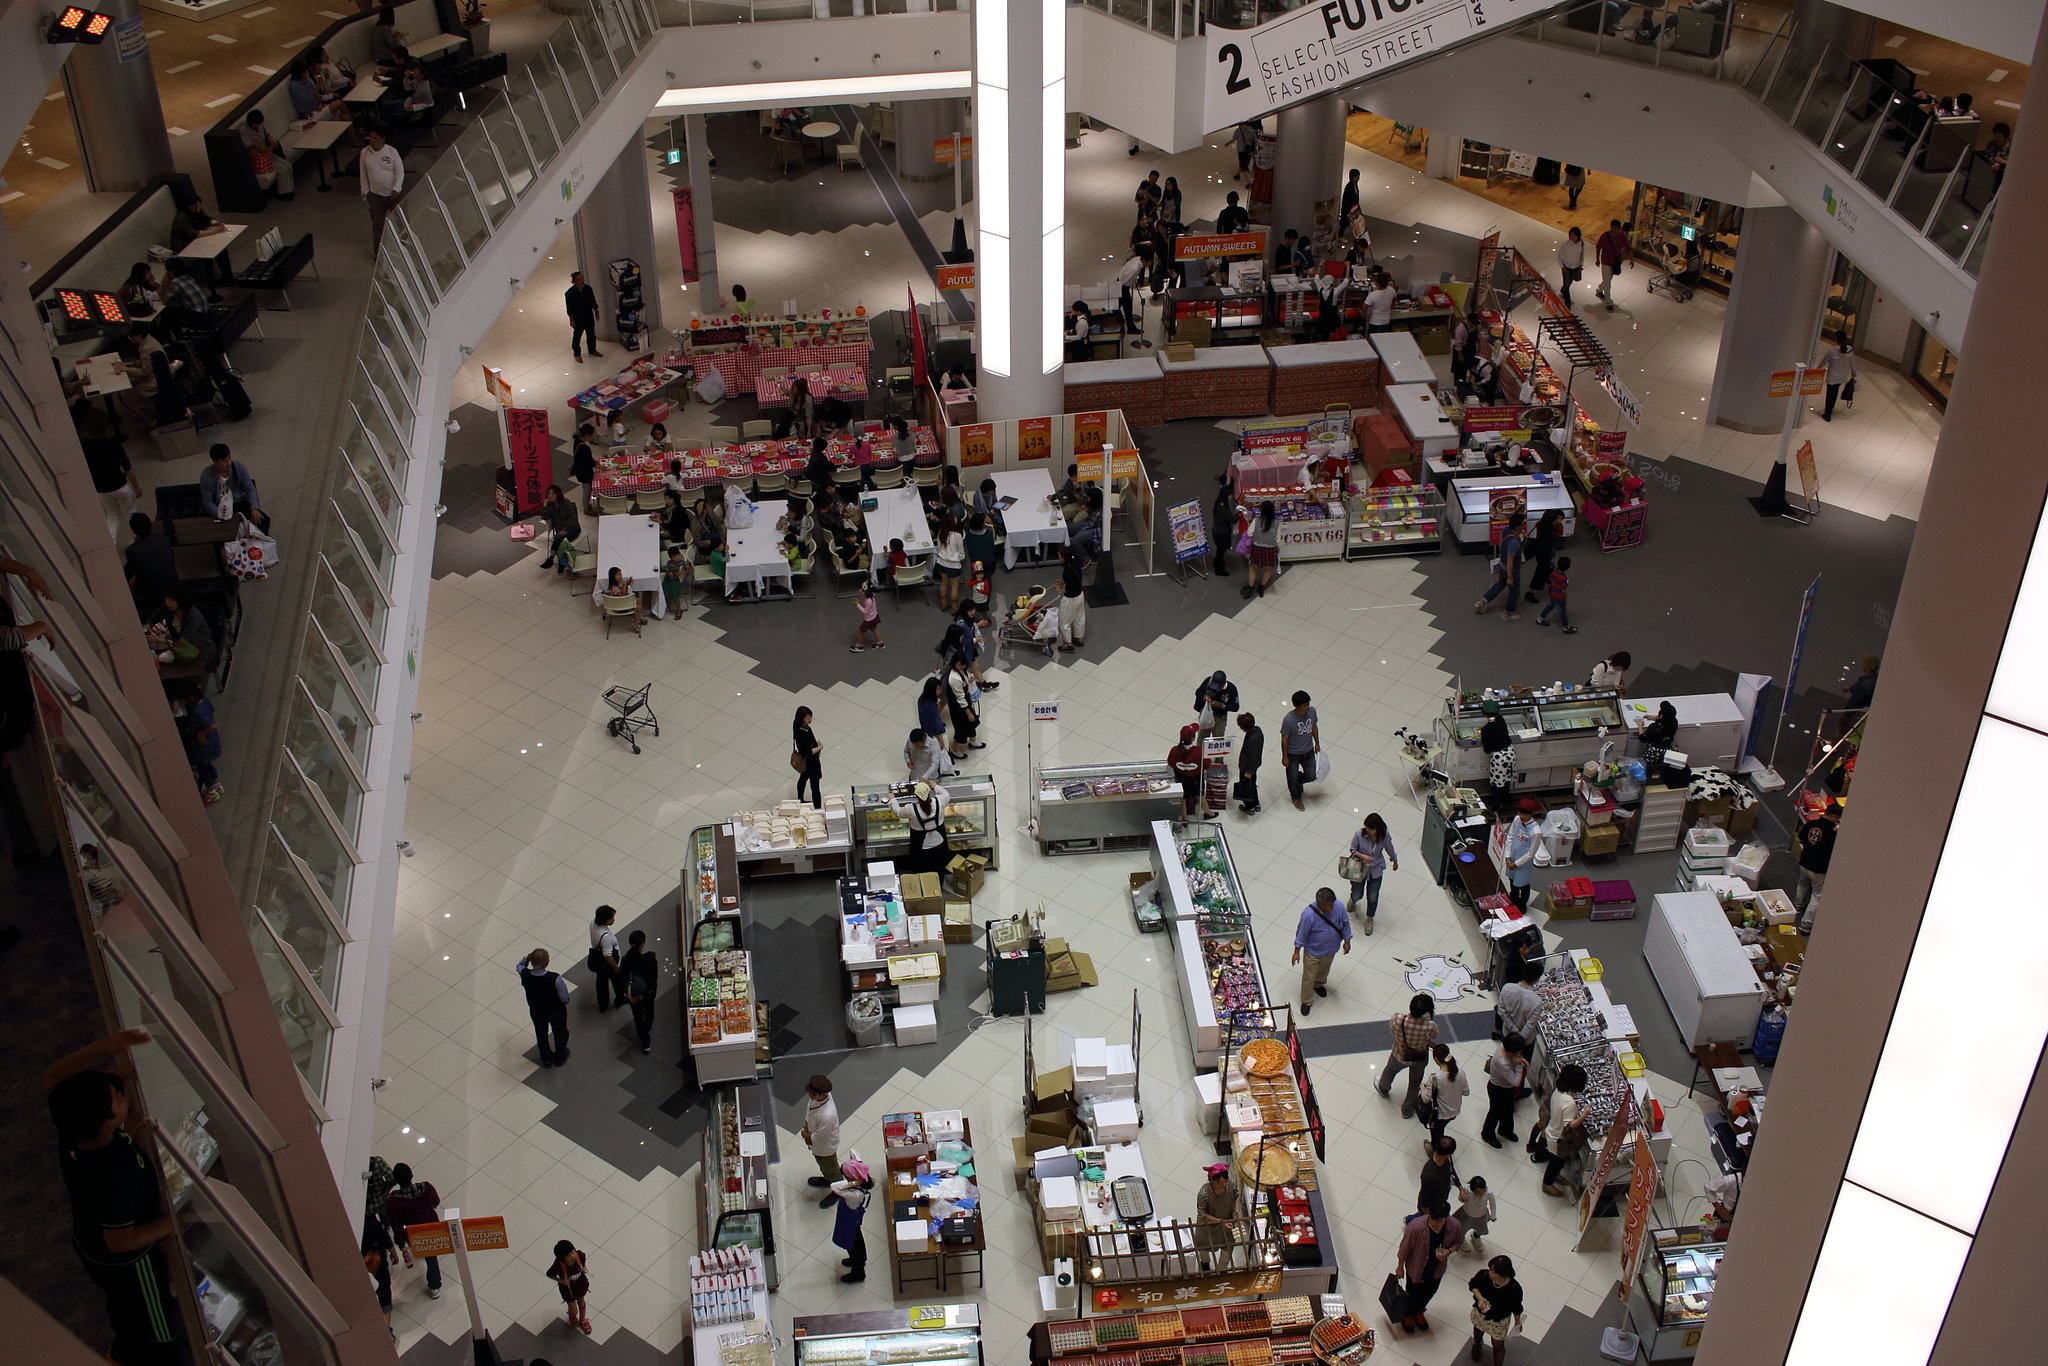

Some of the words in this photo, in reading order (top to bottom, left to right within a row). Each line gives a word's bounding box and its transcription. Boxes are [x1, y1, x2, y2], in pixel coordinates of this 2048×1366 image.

[1320, 0, 1424, 39] FUT
[1261, 38, 1327, 79] SELECT
[1268, 58, 1350, 103] FASHION
[1361, 25, 1434, 68] STREET
[1218, 43, 1252, 95] 2
[1183, 243, 1220, 254] AUTUMN
[1222, 241, 1257, 252] SWEETS
[1257, 436, 1291, 445] POPCORN
[522, 412, 542, 504] スイーツデコ体験
[1281, 531, 1322, 545] CORN
[1297, 718, 1312, 735] M
[1404, 961, 1417, 970] N
[1448, 957, 1460, 965] E
[1462, 987, 1475, 995] S
[412, 1235, 450, 1246] AUTUMN
[466, 1230, 504, 1239] AUTUMN
[415, 1242, 451, 1253] SWEETS
[469, 1237, 504, 1246] SWEETS
